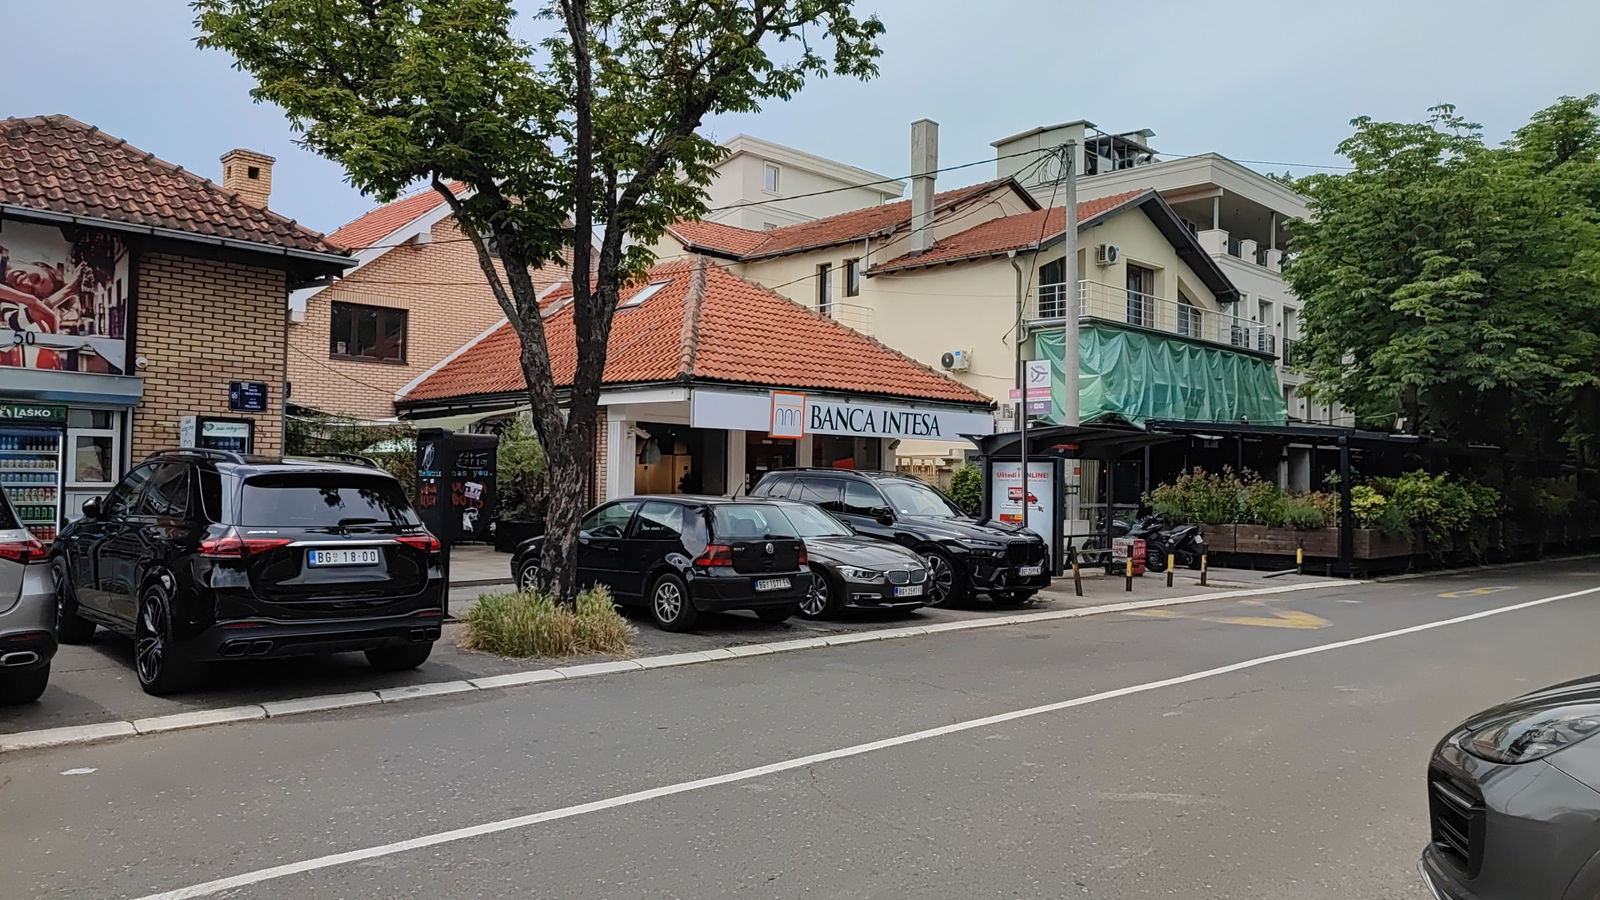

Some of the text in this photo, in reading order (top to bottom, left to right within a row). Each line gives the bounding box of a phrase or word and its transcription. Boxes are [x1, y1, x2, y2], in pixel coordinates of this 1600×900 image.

[13, 330, 35, 346] 50
[14, 407, 51, 419] LAŠKO
[810, 404, 941, 437] BANCA INTESA
[318, 551, 332, 563] BG
